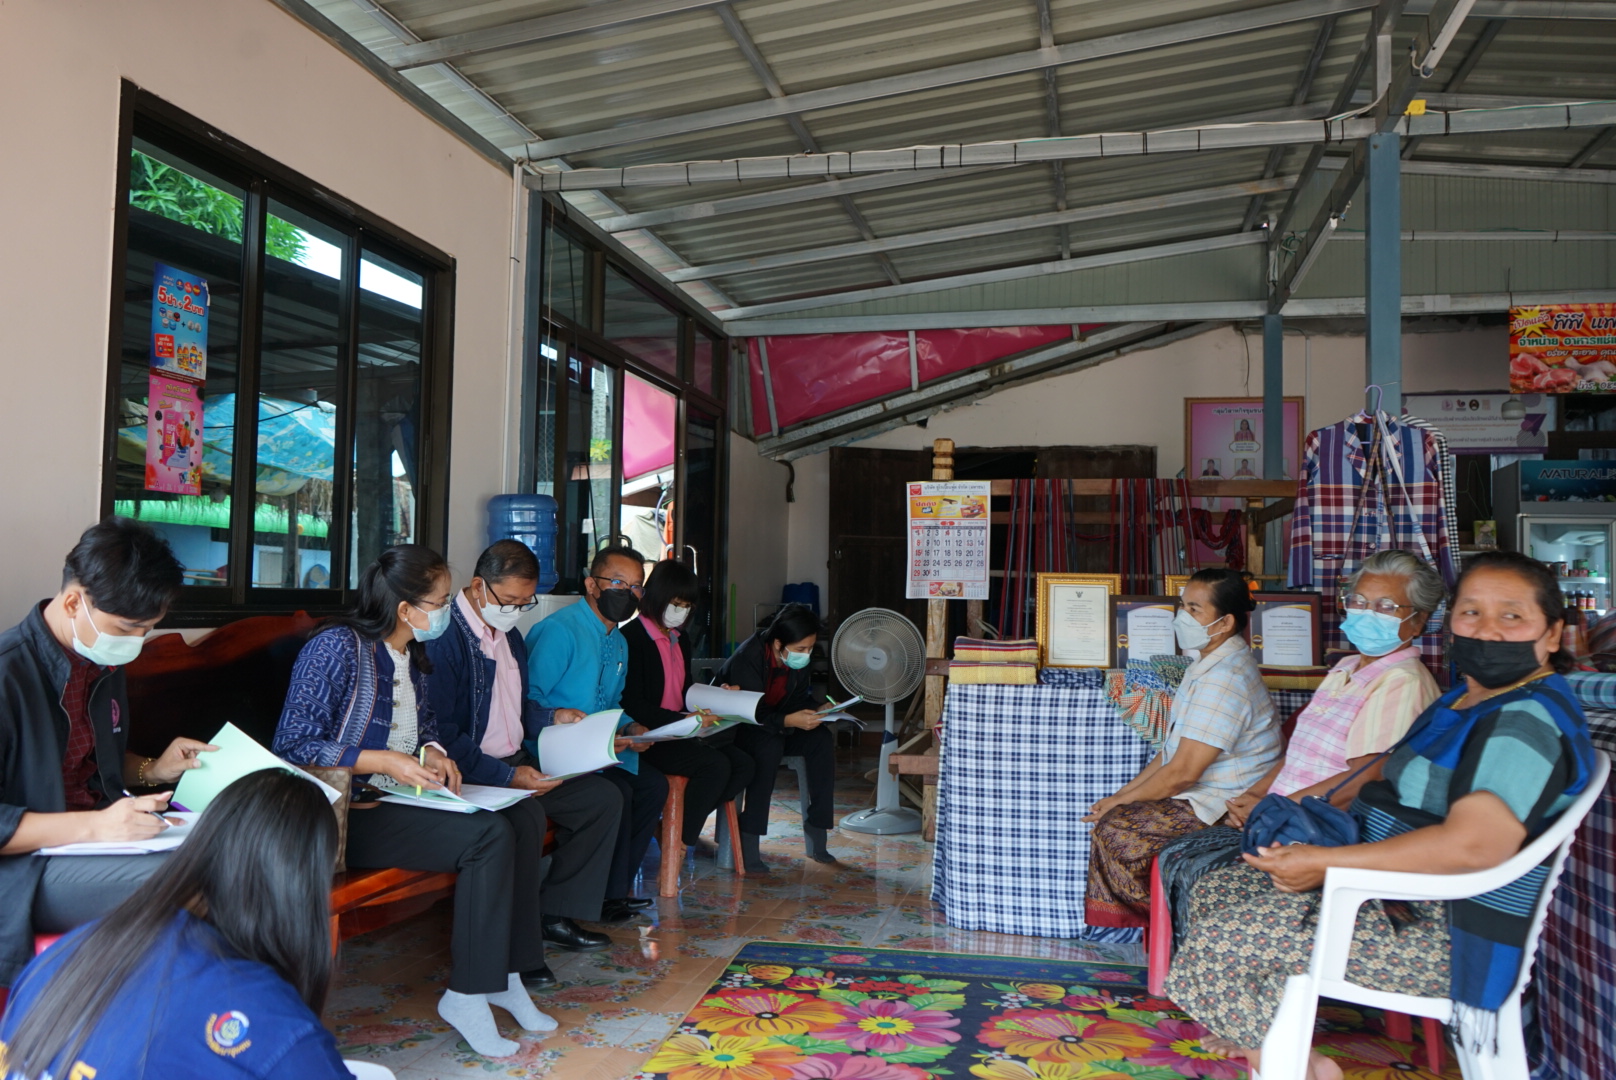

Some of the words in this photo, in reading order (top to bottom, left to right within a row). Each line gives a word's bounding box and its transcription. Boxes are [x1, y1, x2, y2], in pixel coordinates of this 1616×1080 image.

[1519, 335, 1559, 346] จำหน่าย
[926, 529, 931, 537] 2
[956, 529, 961, 537] 5
[967, 529, 972, 537] 6
[979, 529, 983, 537] 7
[916, 539, 921, 547] 8
[977, 539, 984, 547] 14
